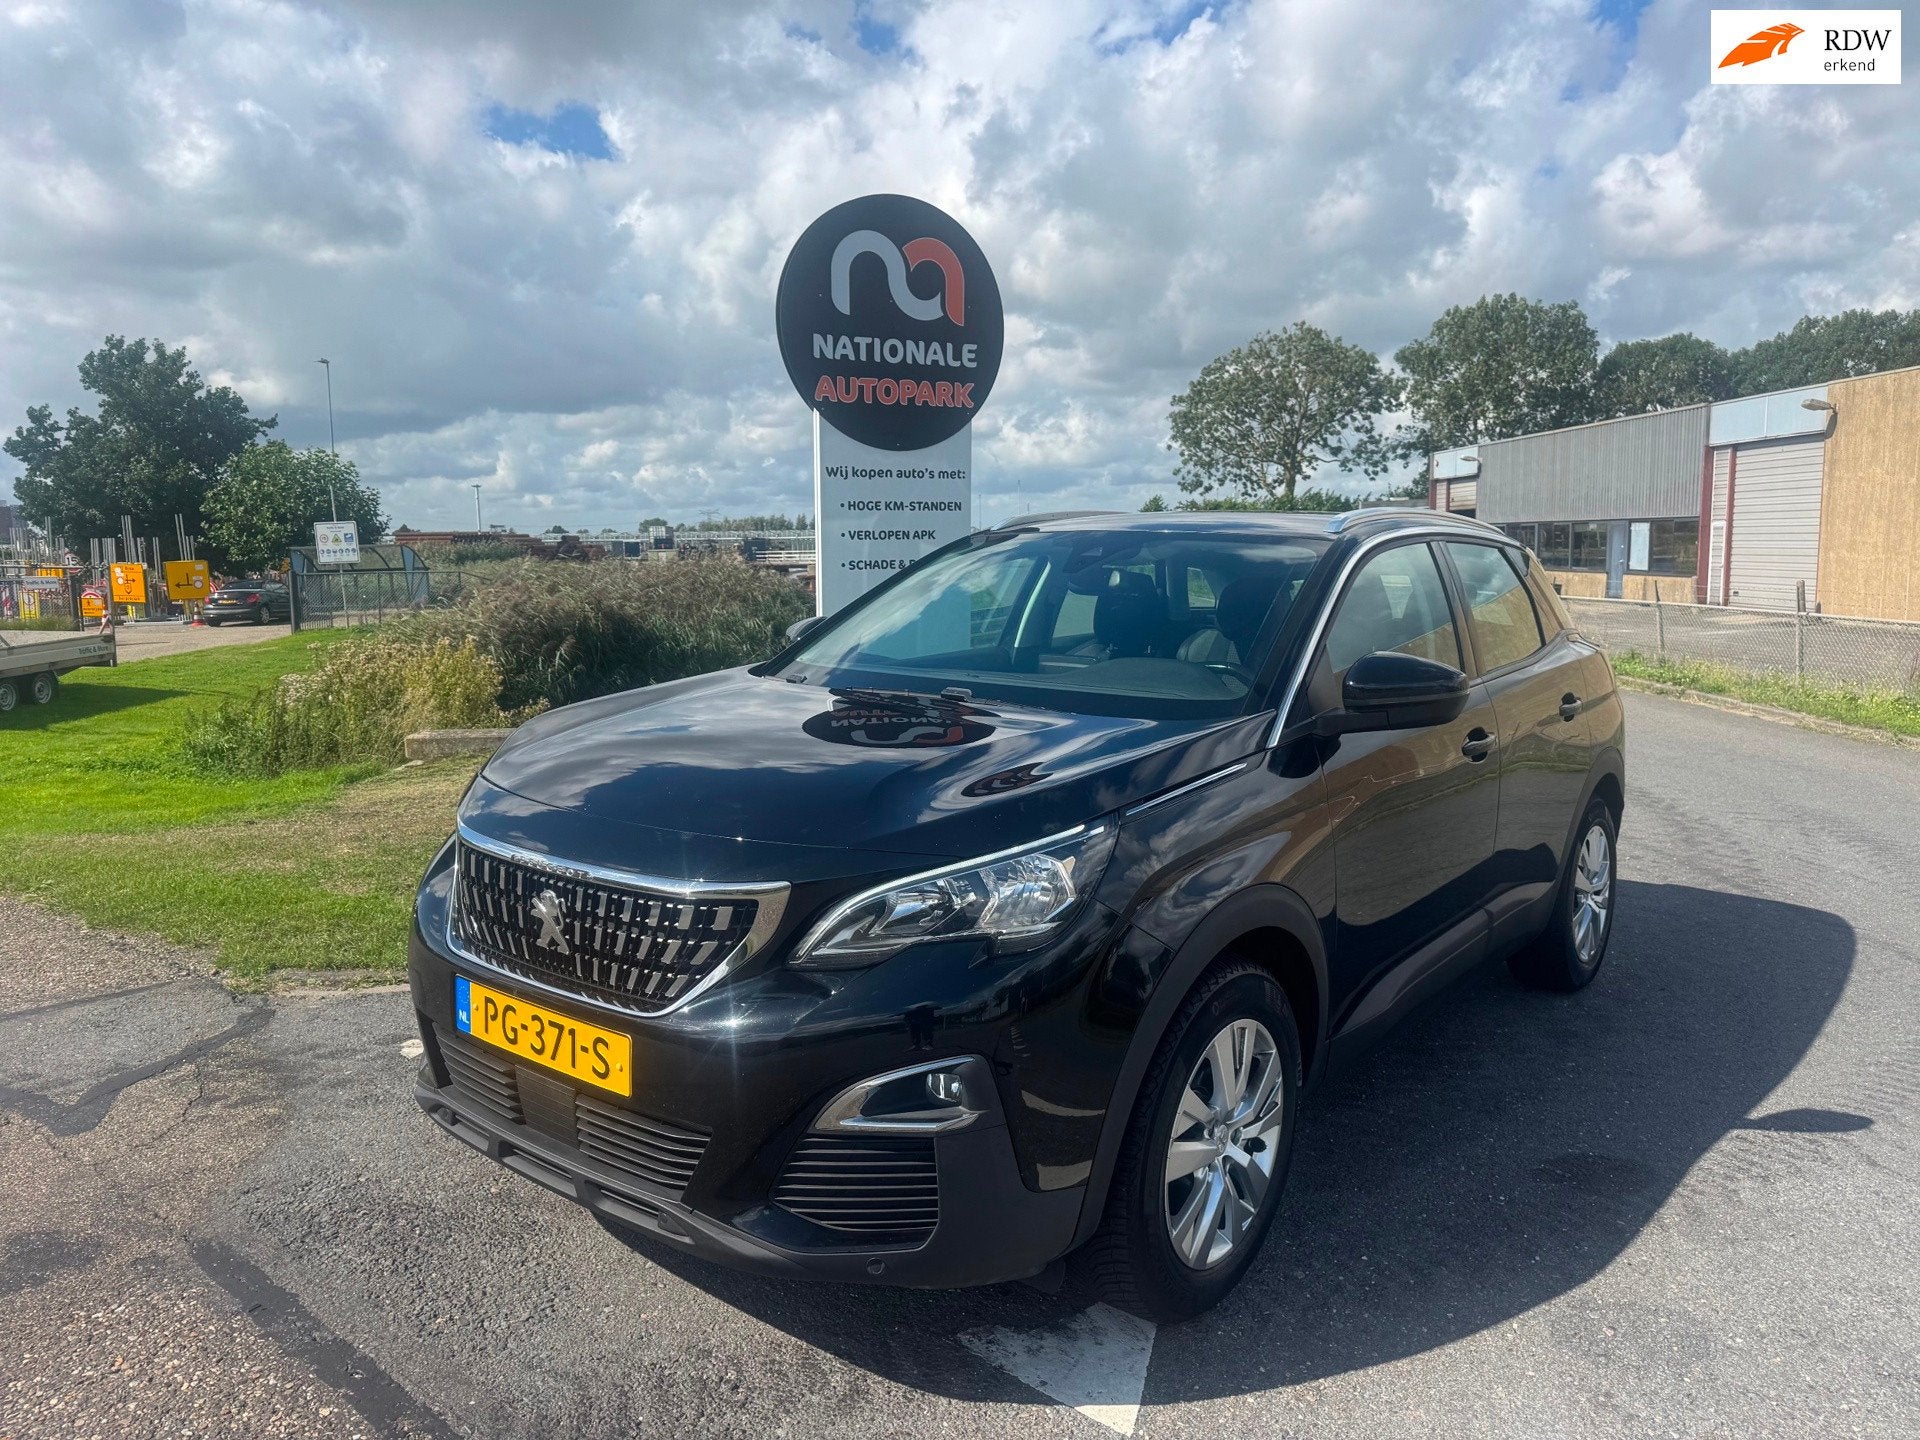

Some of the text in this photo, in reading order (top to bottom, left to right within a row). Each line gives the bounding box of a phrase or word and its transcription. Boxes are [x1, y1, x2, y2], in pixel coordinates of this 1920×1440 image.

[812, 333, 978, 368] NATIONALE
[814, 374, 975, 408] AUTOPARK
[825, 466, 966, 480] Wij kopen auto's met:
[847, 501, 962, 512] HOGE KM-STANDEN
[848, 530, 936, 541] VERLOPEN APK
[848, 559, 896, 571] SCHADE
[898, 559, 906, 570] &
[458, 1009, 469, 1024] NL
[484, 995, 611, 1081] PG-371-S
